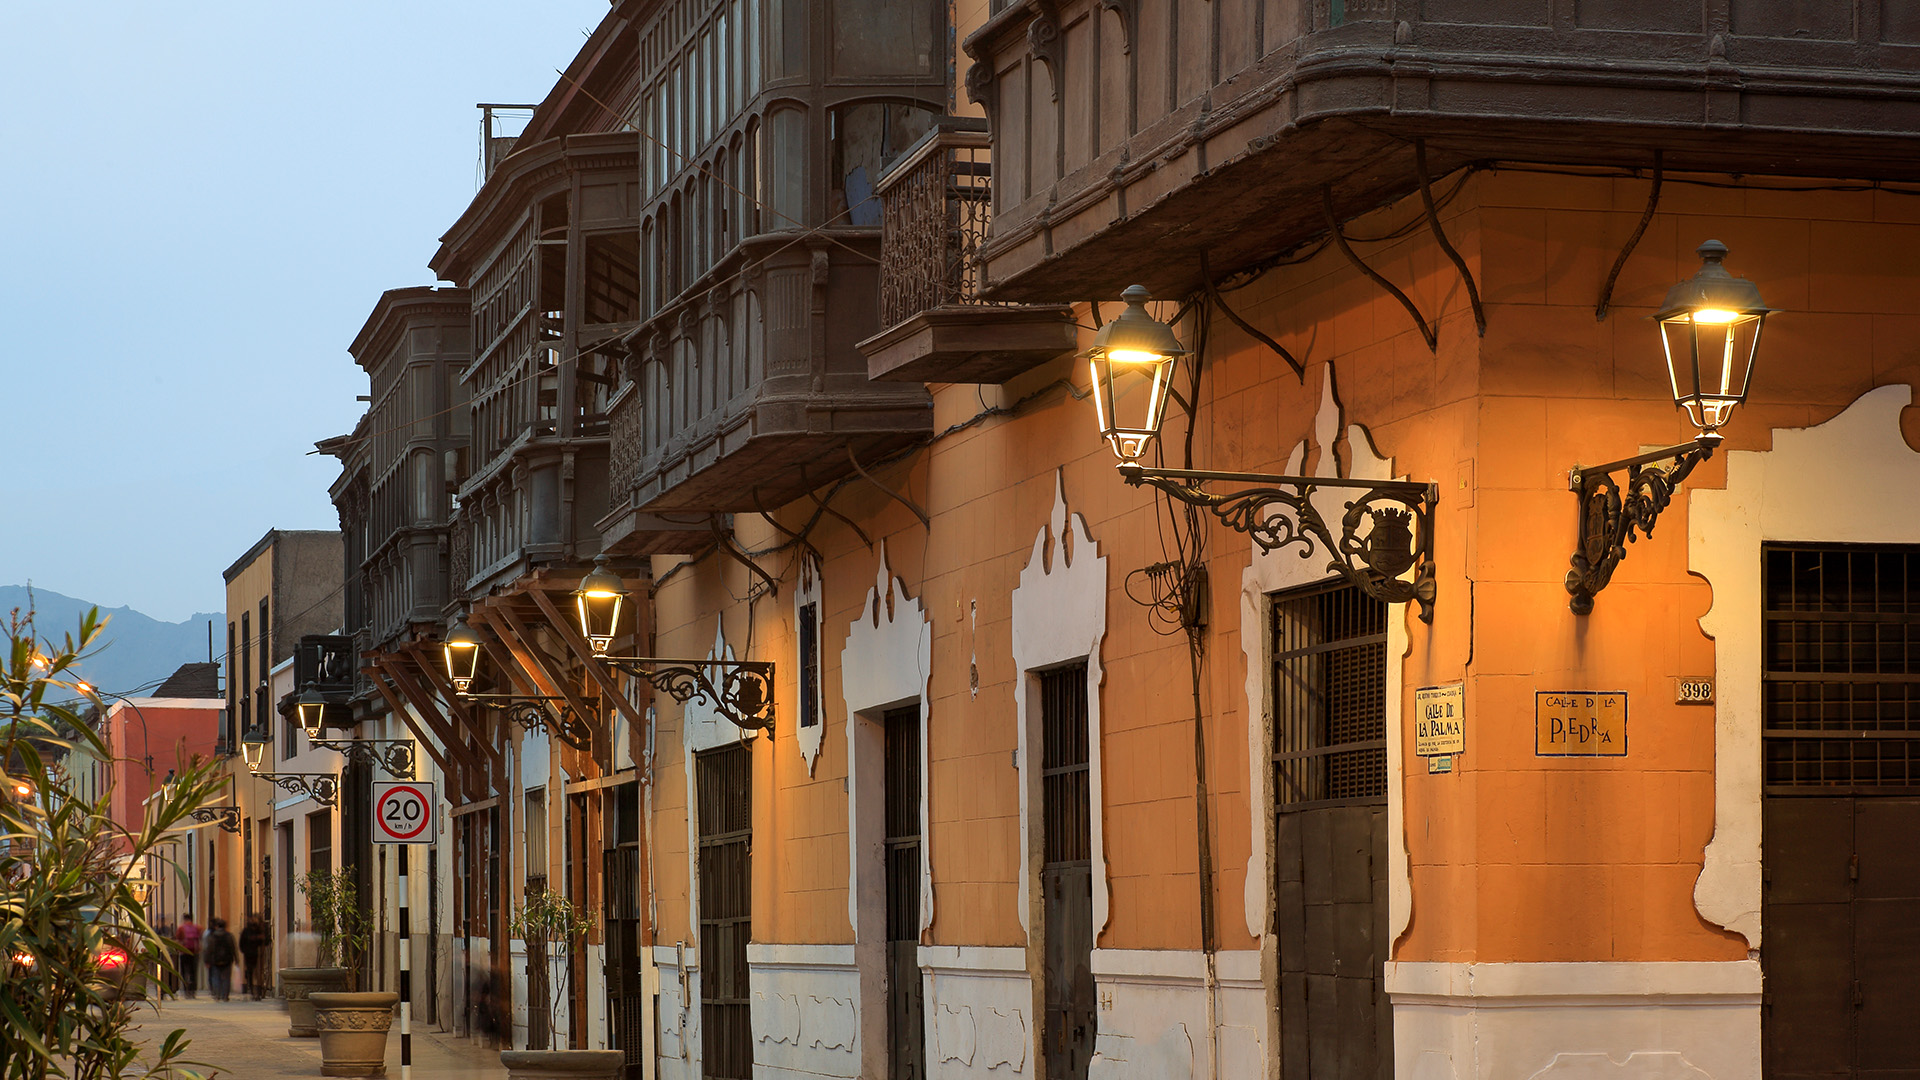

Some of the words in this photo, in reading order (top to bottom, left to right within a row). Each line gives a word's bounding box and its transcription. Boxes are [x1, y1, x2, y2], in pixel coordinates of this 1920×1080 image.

[1683, 683, 1710, 698] 398
[1545, 696, 1578, 708] CALLE
[1604, 697, 1616, 708] LA
[1425, 704, 1443, 720] CALLE
[1446, 703, 1454, 717] DE
[1419, 722, 1428, 737] LA
[1430, 720, 1460, 737] PALMA
[1550, 717, 1612, 743] PIEDRA
[386, 799, 420, 821] 20
